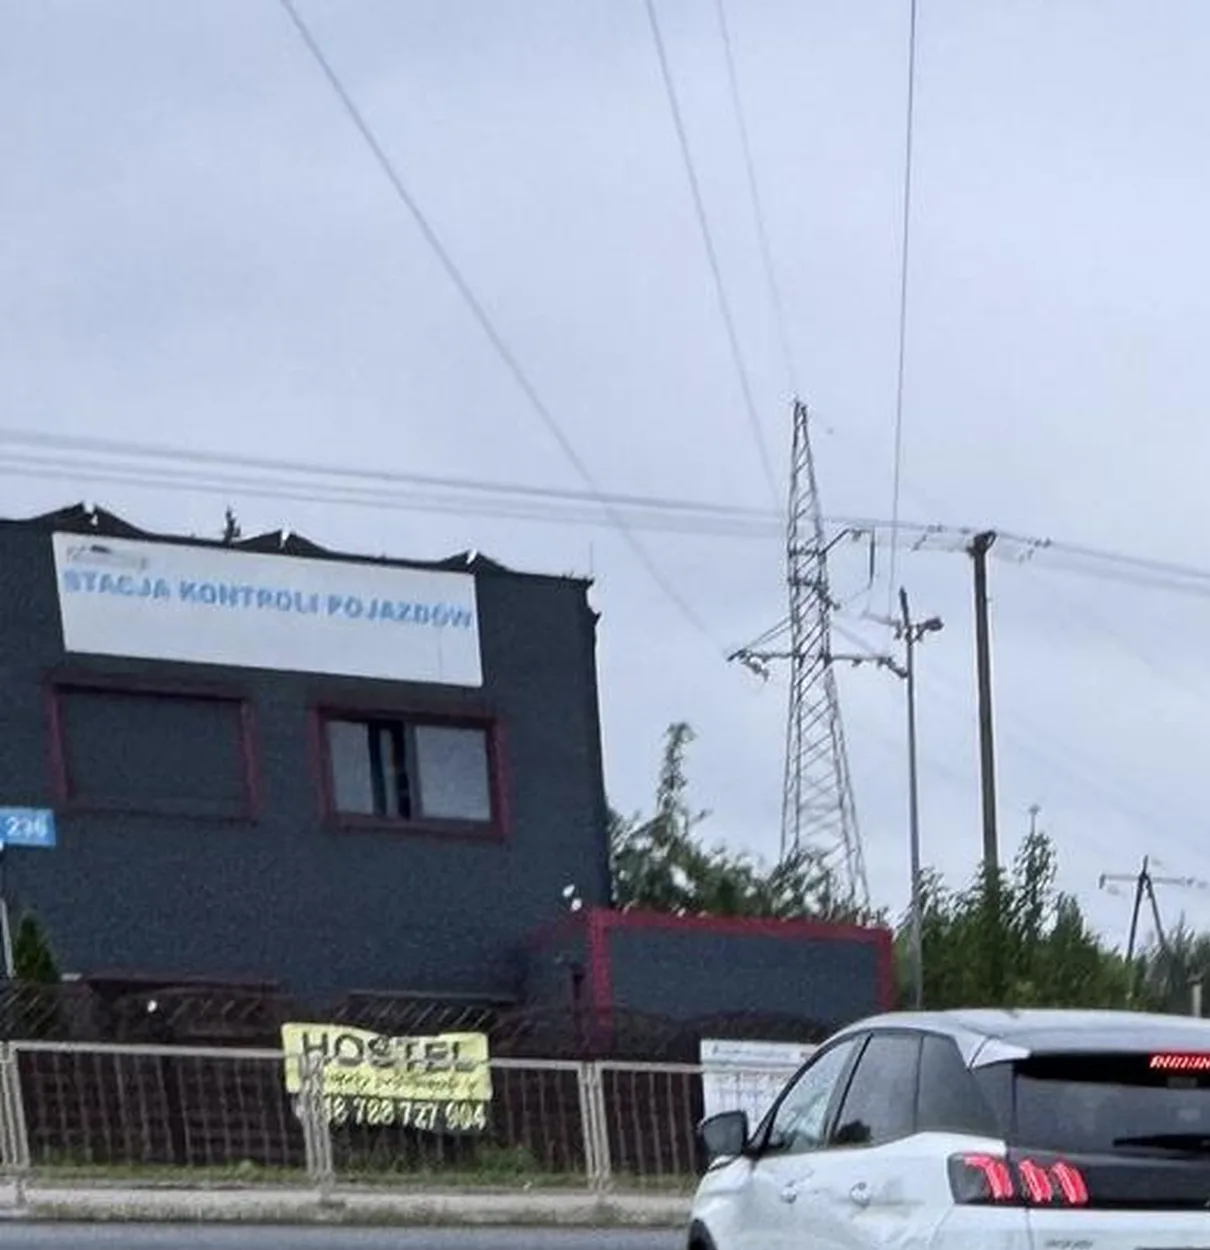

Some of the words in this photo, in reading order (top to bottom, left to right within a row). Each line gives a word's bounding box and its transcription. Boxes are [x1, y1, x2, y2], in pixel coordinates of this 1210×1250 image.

[64, 566, 171, 600] STACJA
[180, 579, 320, 616] KONTROLI
[302, 1031, 482, 1073] HOSTEL
